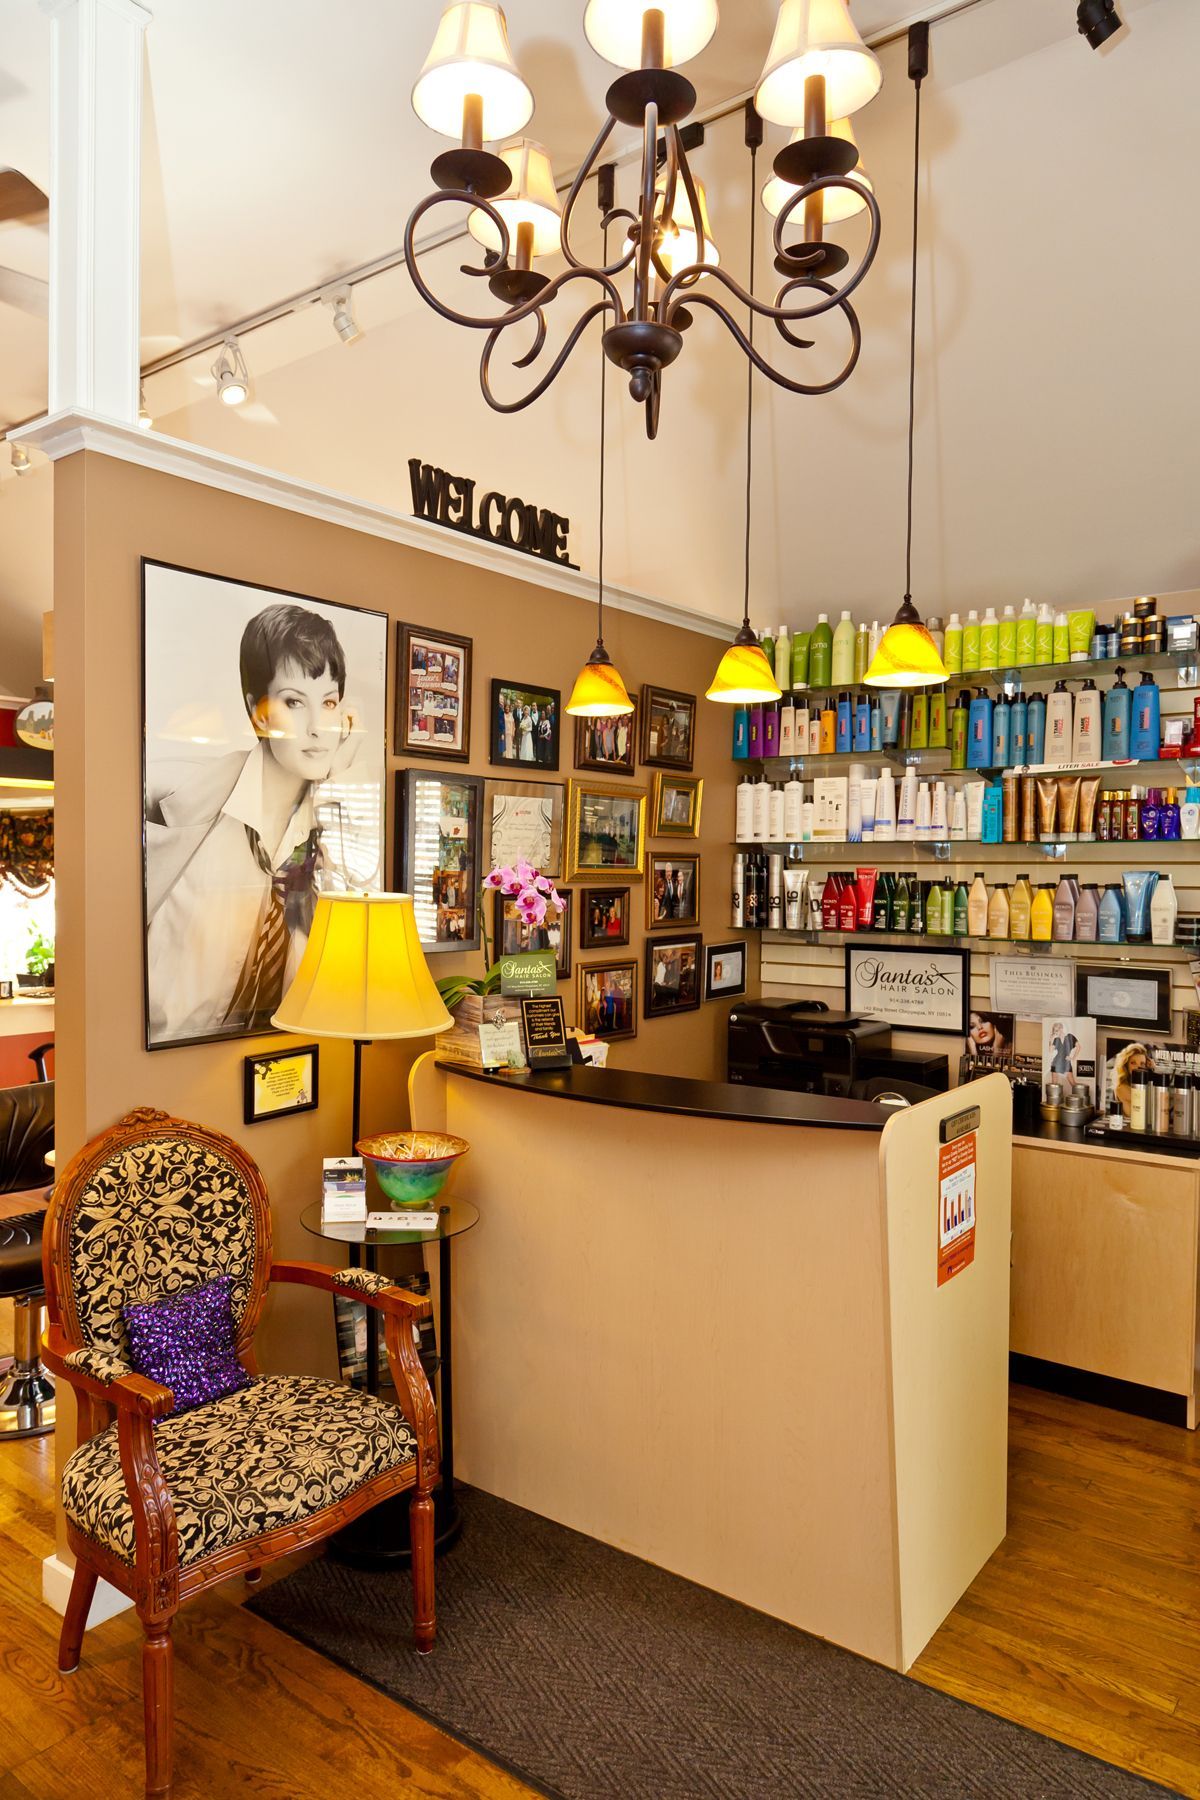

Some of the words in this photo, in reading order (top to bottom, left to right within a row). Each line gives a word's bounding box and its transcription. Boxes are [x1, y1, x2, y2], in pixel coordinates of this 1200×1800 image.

[408, 458, 570, 565] WELCOME
[770, 896, 780, 912] 18
[787, 890, 798, 904] 16
[501, 960, 542, 978] Santa's
[855, 958, 934, 988] Santa's
[880, 985, 907, 993] HAIR
[914, 986, 955, 996] SALON
